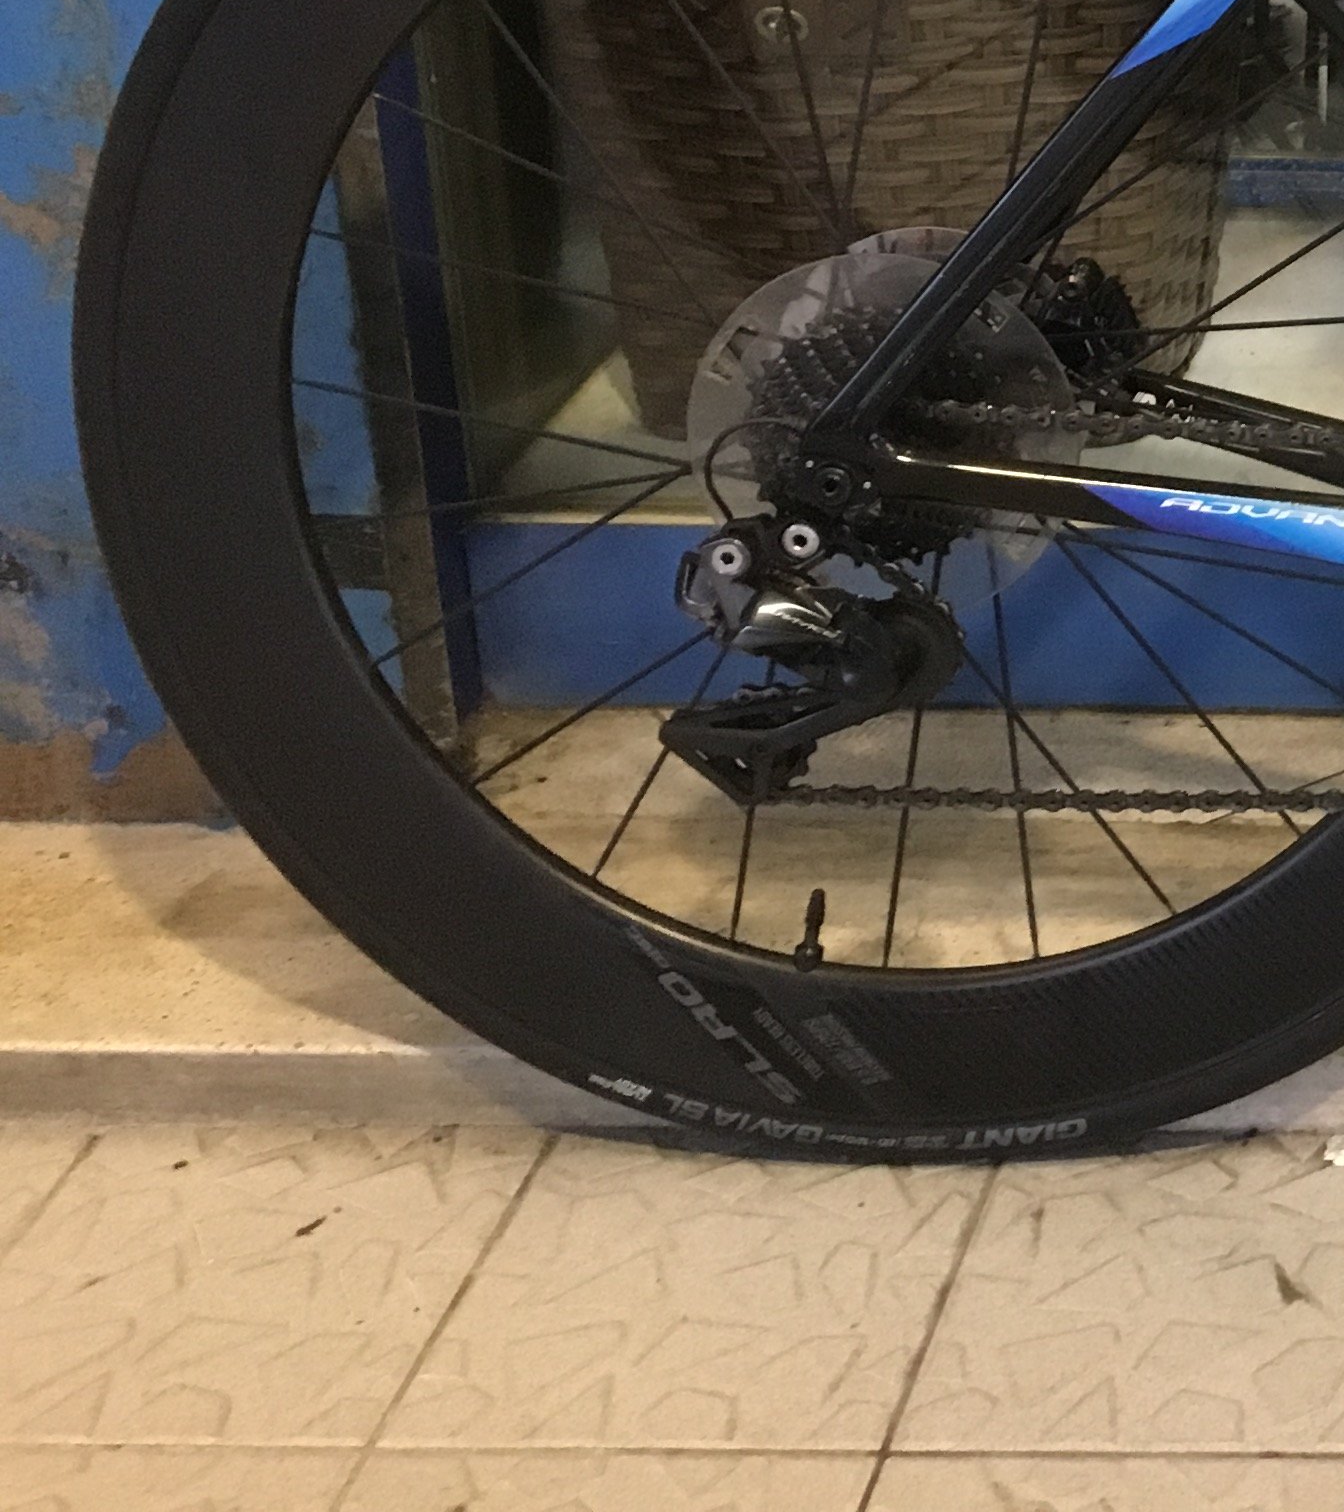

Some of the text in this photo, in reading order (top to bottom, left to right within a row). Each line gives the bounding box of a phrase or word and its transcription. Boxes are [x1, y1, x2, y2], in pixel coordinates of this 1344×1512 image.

[661, 1092, 711, 1122] SL
[714, 1103, 825, 1147] GAVIA
[957, 1115, 1090, 1151] GIANT
